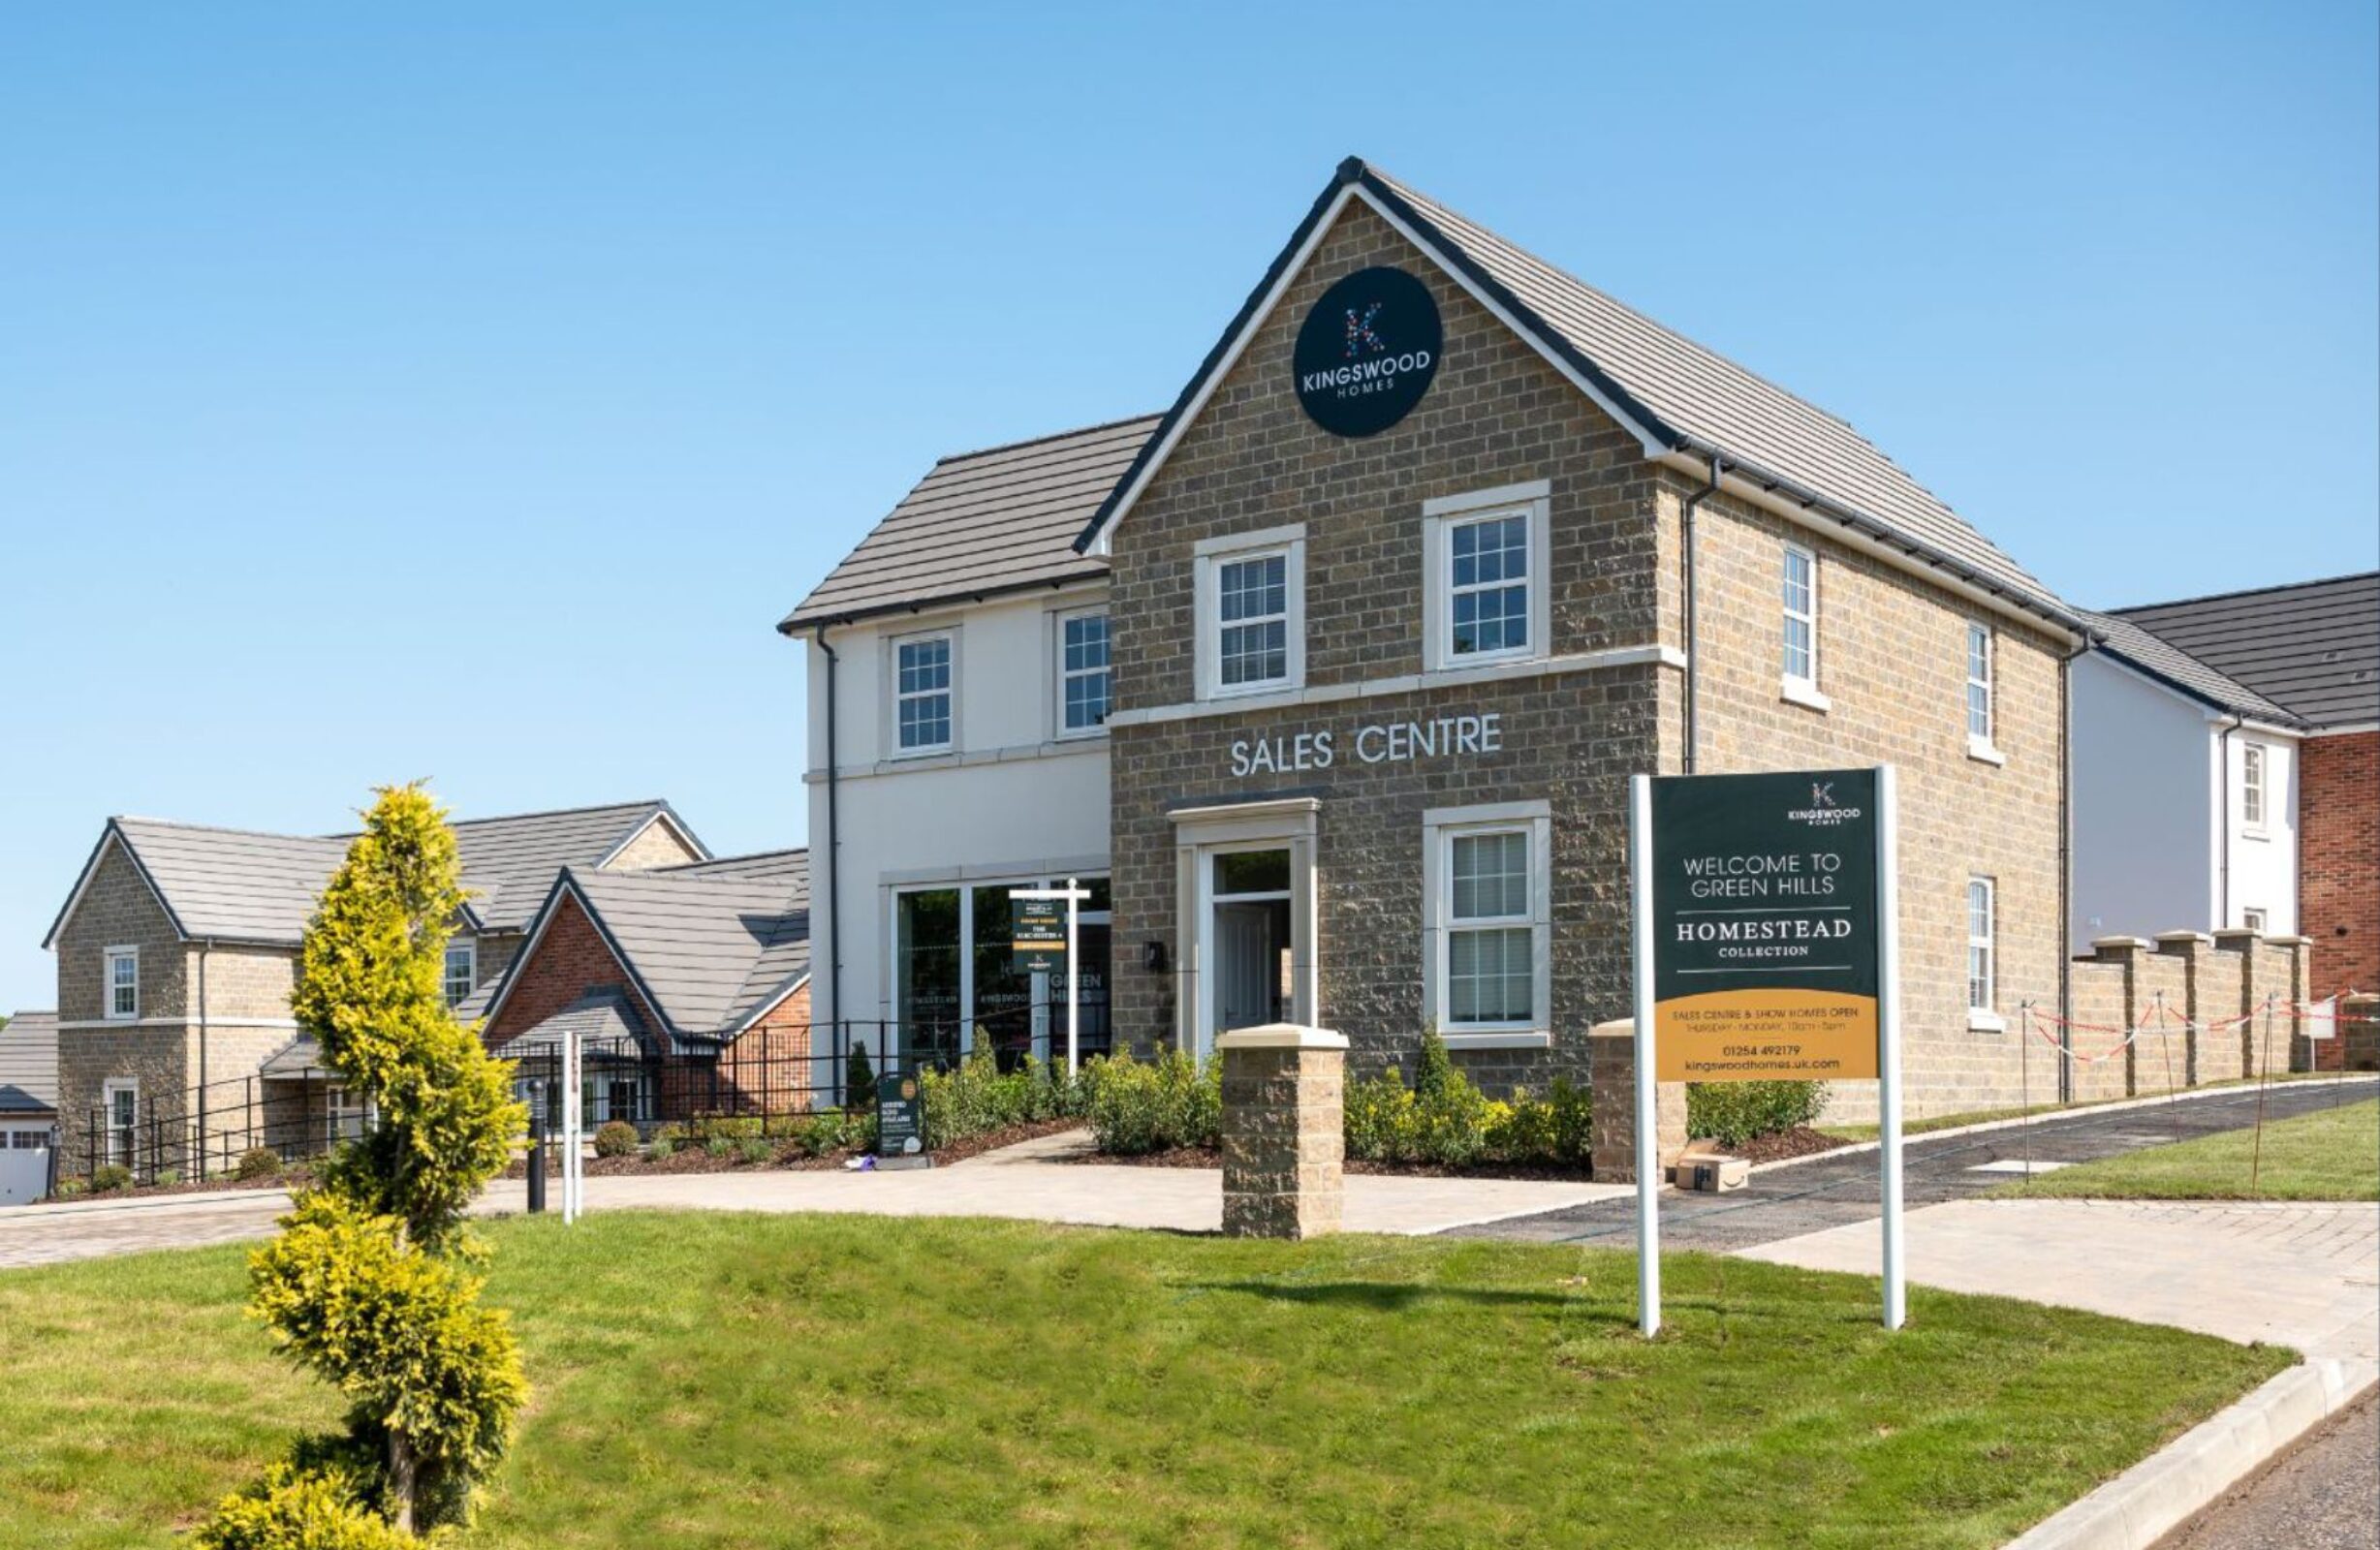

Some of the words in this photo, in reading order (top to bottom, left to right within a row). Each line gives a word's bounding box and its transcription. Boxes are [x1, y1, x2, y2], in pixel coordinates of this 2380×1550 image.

[1303, 351, 1430, 392] KINGSWOOD
[1337, 377, 1394, 398] HOMES
[1231, 730, 1333, 776] SALES
[1357, 713, 1501, 763] CENTRE
[1788, 808, 1861, 820] KINGSWOOD
[1683, 854, 1801, 876] WELCOME
[1810, 853, 1840, 872] TO
[1691, 878, 1768, 897] GREEN
[1778, 876, 1834, 895] HILLS
[1675, 918, 1851, 941] HOMESTEAD
[1718, 946, 1808, 957] COLLECTION
[1051, 989, 1092, 1004] HIS
[1673, 1010, 1701, 1020] SALES
[1704, 1009, 1741, 1020] CENTRE
[1756, 1009, 1786, 1018] SHOW
[1790, 1008, 1827, 1017] HOMES
[1830, 1008, 1858, 1017] OPEN
[1723, 1046, 1757, 1056] 01254
[1761, 1045, 1801, 1056] 492179
[1685, 1059, 1839, 1072] kingswoodhomes.uk.com
